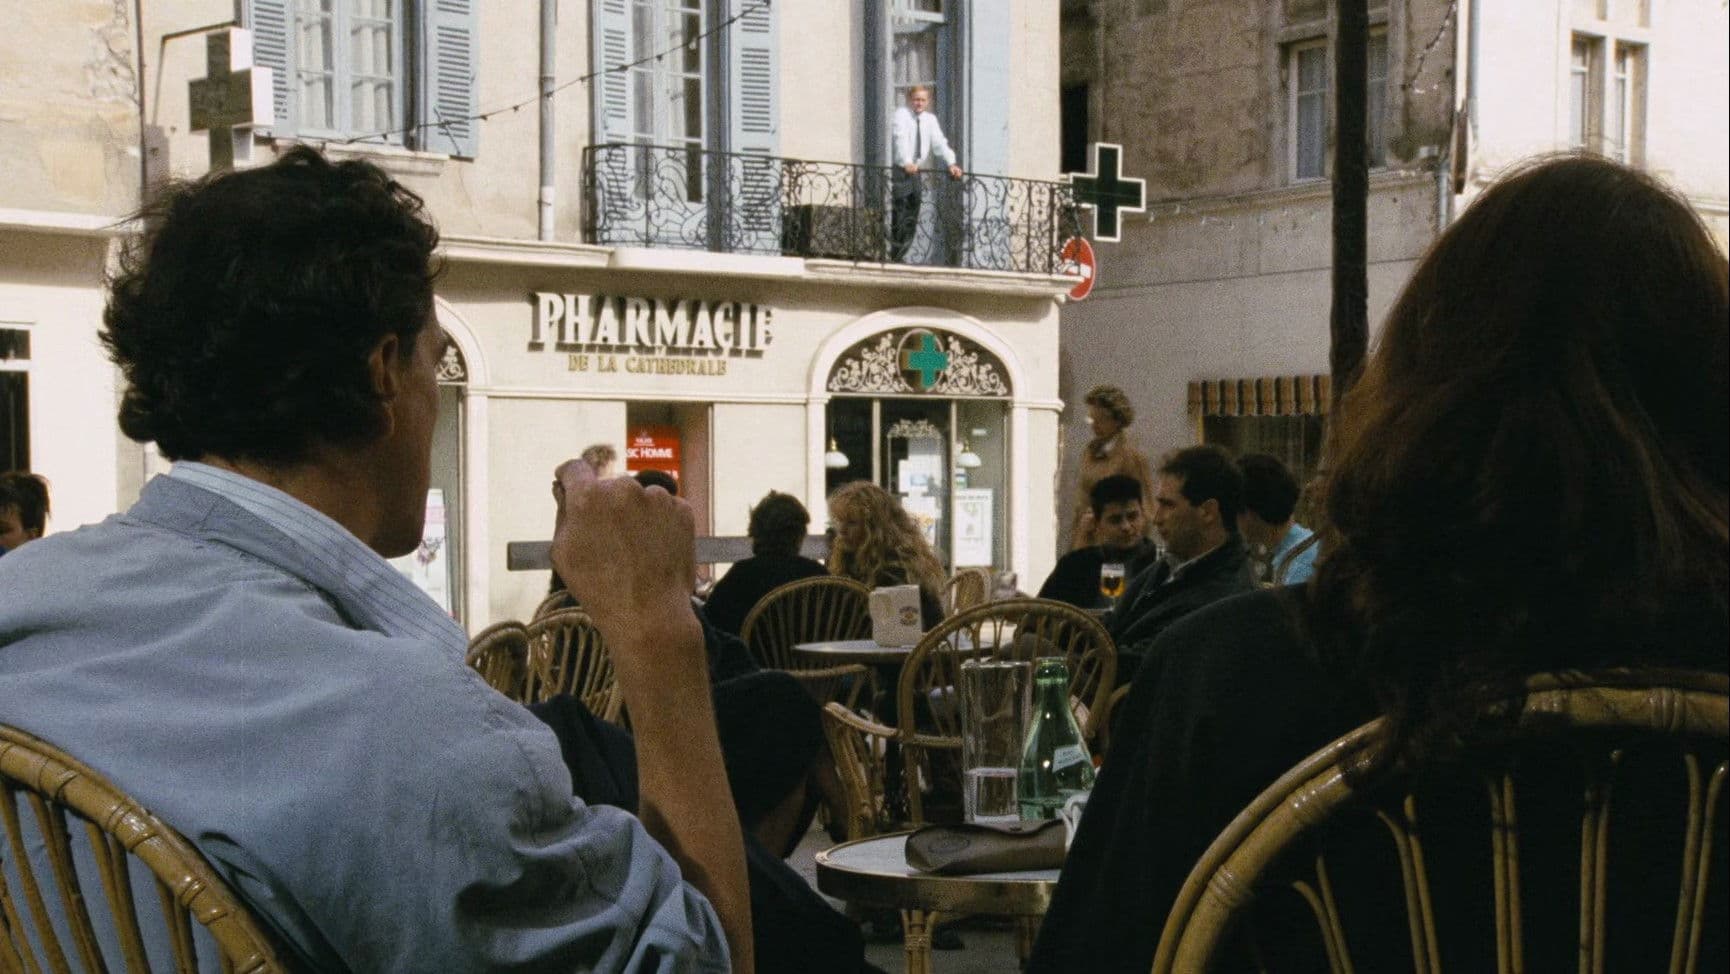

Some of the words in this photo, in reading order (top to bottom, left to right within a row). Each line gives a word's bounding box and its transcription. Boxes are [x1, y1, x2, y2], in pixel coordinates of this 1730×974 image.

[534, 291, 774, 350] PHARMACIE
[567, 354, 589, 371] DE
[597, 355, 618, 373] LA
[625, 356, 728, 376] CATHEDRALE
[640, 447, 673, 458] HOMME
